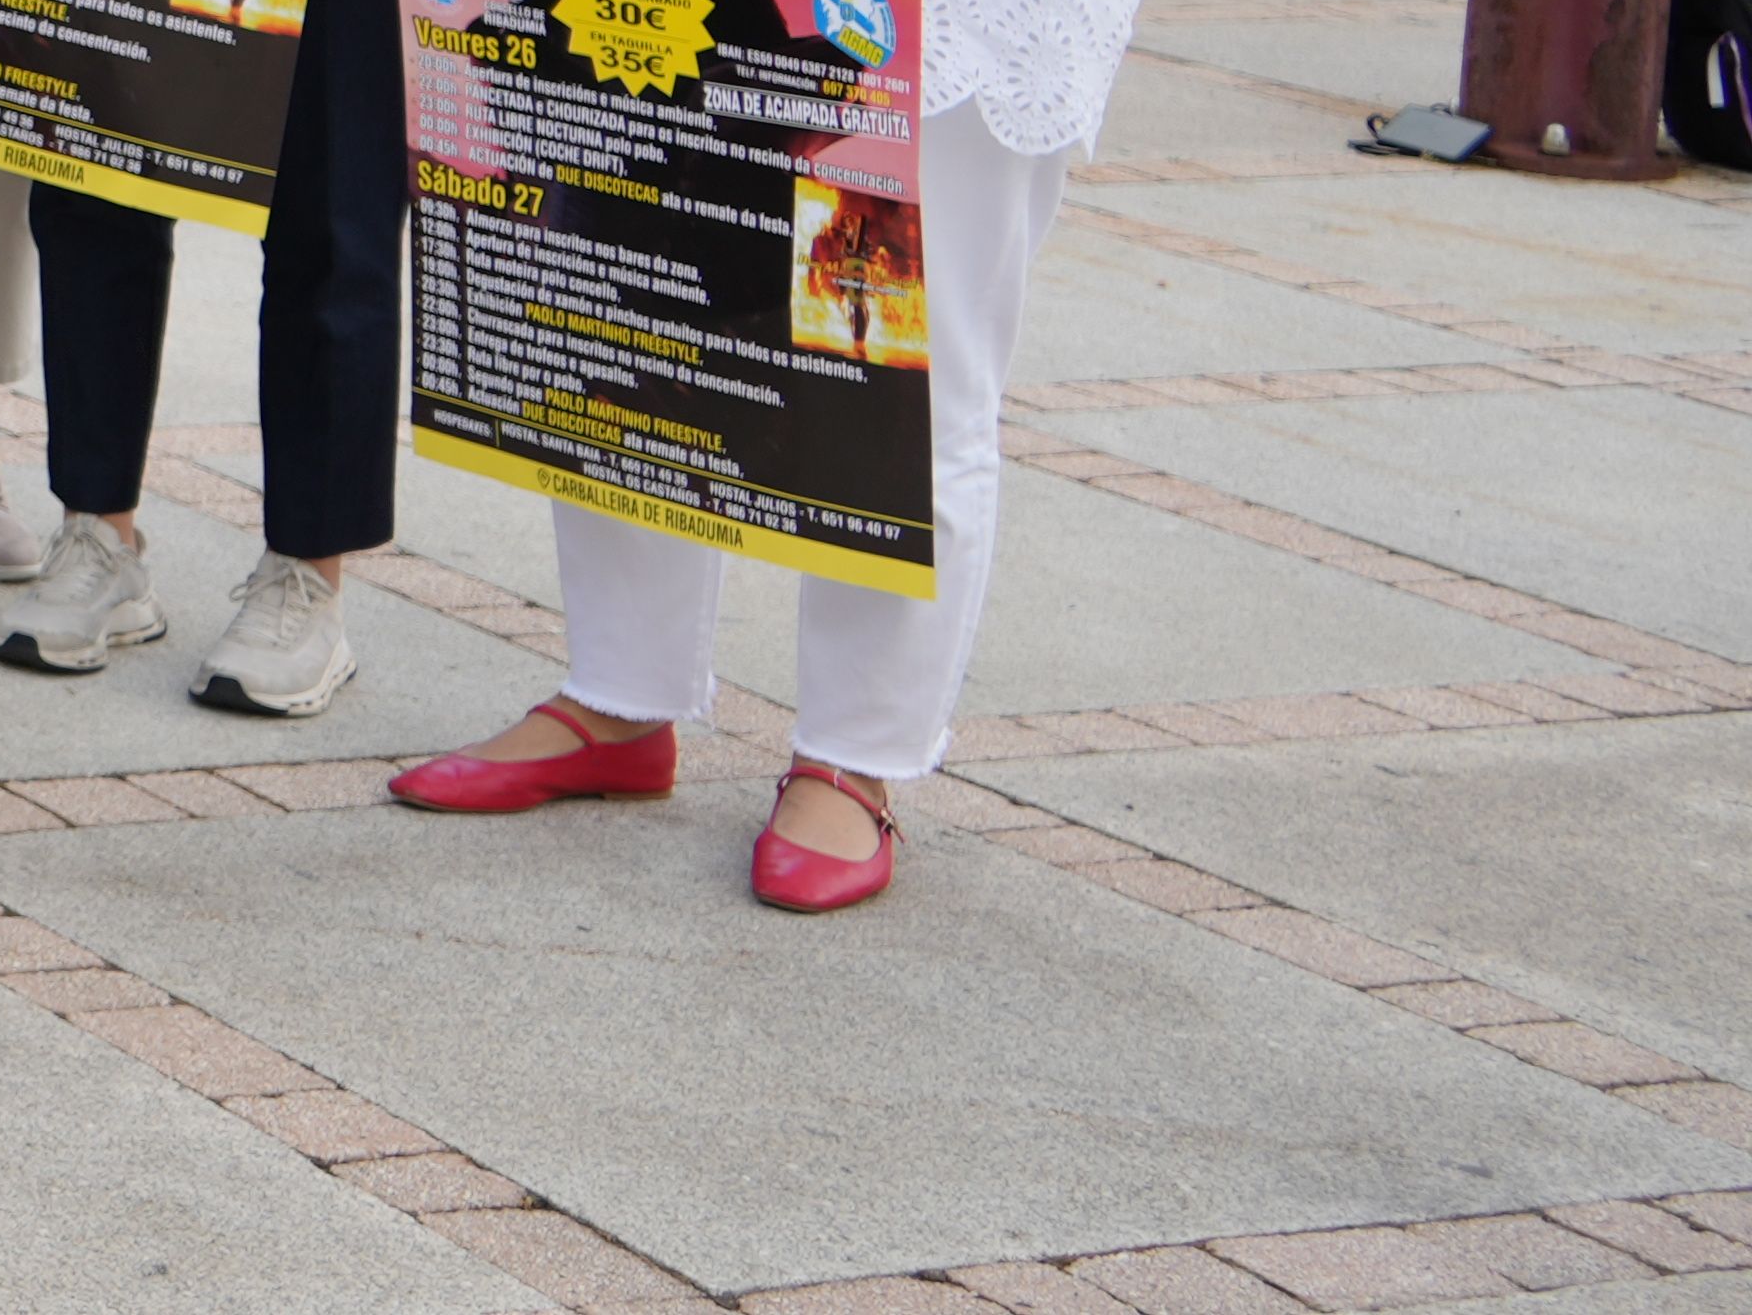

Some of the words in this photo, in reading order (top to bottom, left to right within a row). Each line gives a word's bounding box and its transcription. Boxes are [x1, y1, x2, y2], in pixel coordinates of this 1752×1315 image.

[704, 85, 742, 113] ZONA
[743, 92, 762, 115] DE
[764, 95, 837, 128] ACAMPADA
[842, 107, 909, 140] GRATUÍTA
